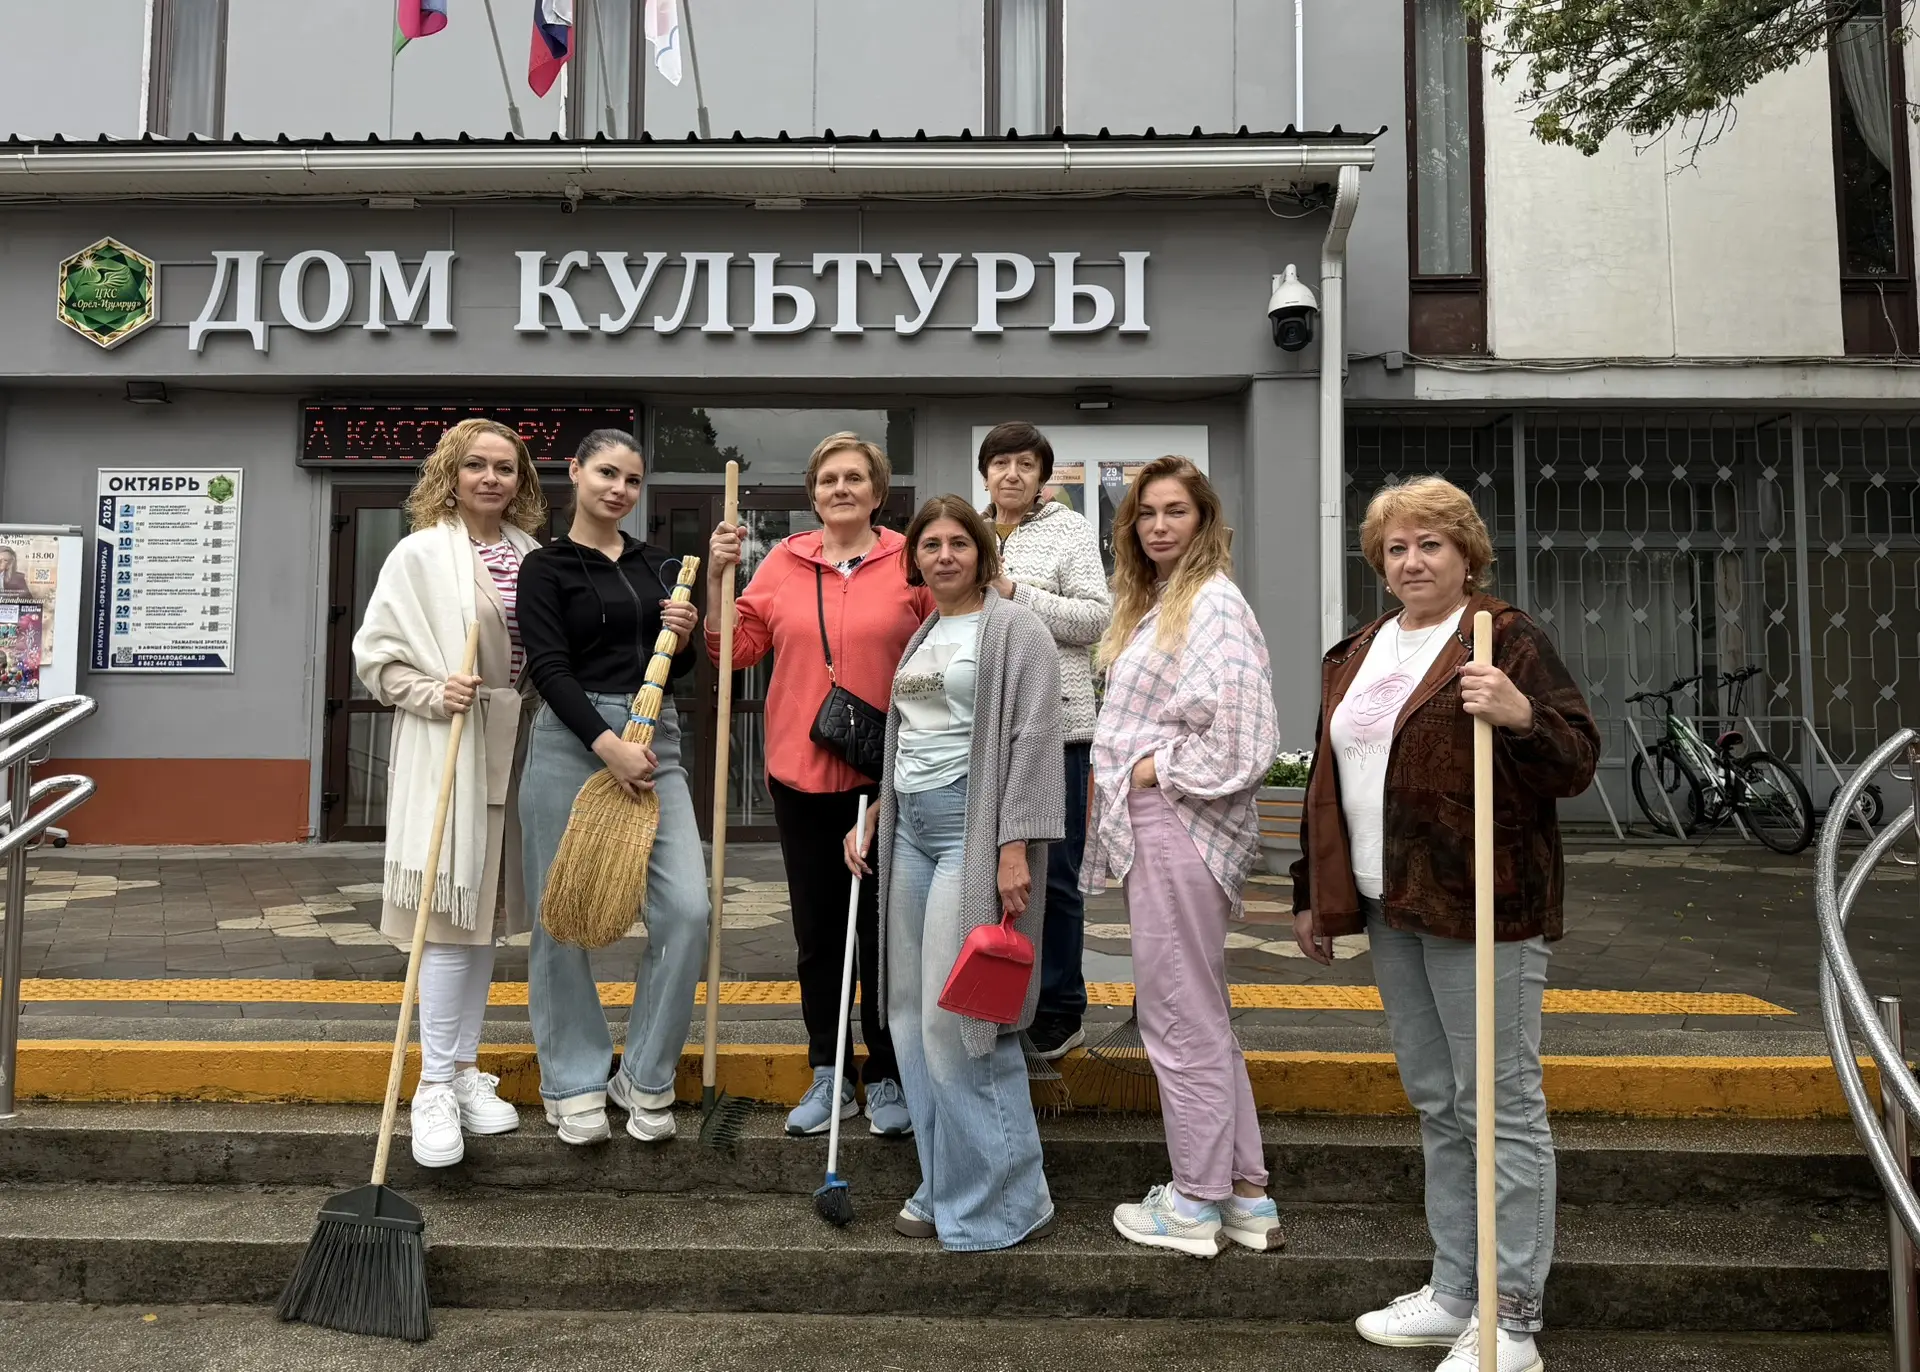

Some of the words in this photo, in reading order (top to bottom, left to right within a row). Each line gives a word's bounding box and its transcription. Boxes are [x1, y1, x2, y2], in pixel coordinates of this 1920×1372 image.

[95, 288, 118, 299] ЦКС
[188, 249, 457, 352] ДОМ
[513, 250, 1151, 336] КУЛЬТУРЫ
[1106, 467, 1118, 477] 29
[109, 477, 200, 492] ОКТЯБРЬ
[102, 498, 113, 525] 2026
[124, 504, 130, 513] 2
[124, 521, 130, 529] 3
[119, 537, 132, 546] 10
[119, 554, 131, 563] 15
[118, 571, 131, 580] 23
[117, 588, 131, 597] 24
[116, 605, 130, 614] 29
[116, 622, 128, 630] 31
